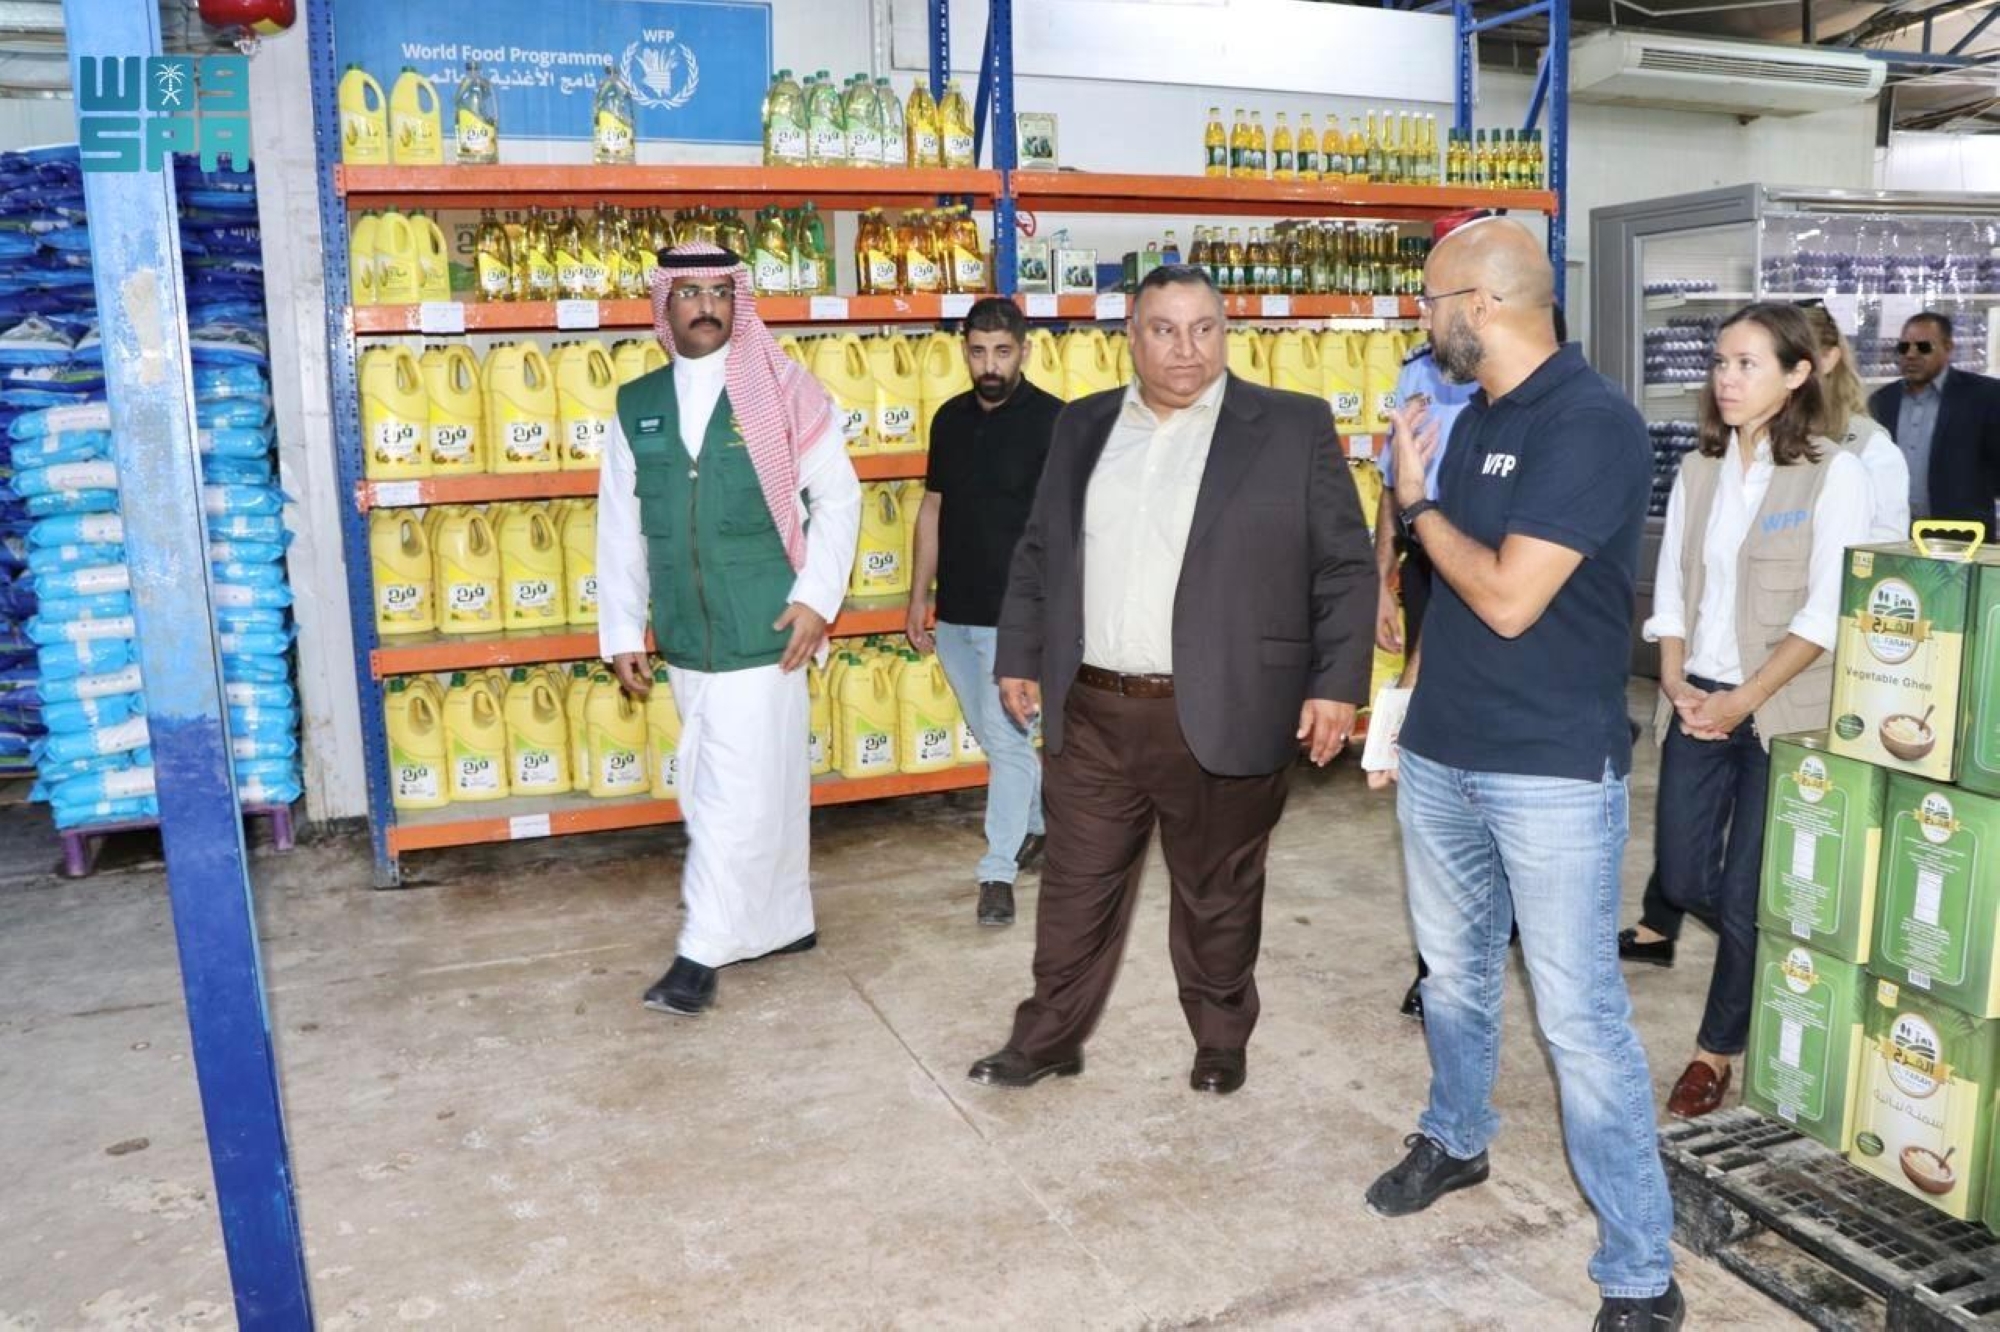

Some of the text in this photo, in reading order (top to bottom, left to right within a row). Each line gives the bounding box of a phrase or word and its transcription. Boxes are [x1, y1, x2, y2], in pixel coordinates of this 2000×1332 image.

[643, 29, 674, 43] WFP
[402, 43, 613, 68] World Food Programme
[1763, 509, 1807, 533] WFP
[1846, 666, 1933, 692] Vegetable Ghee
